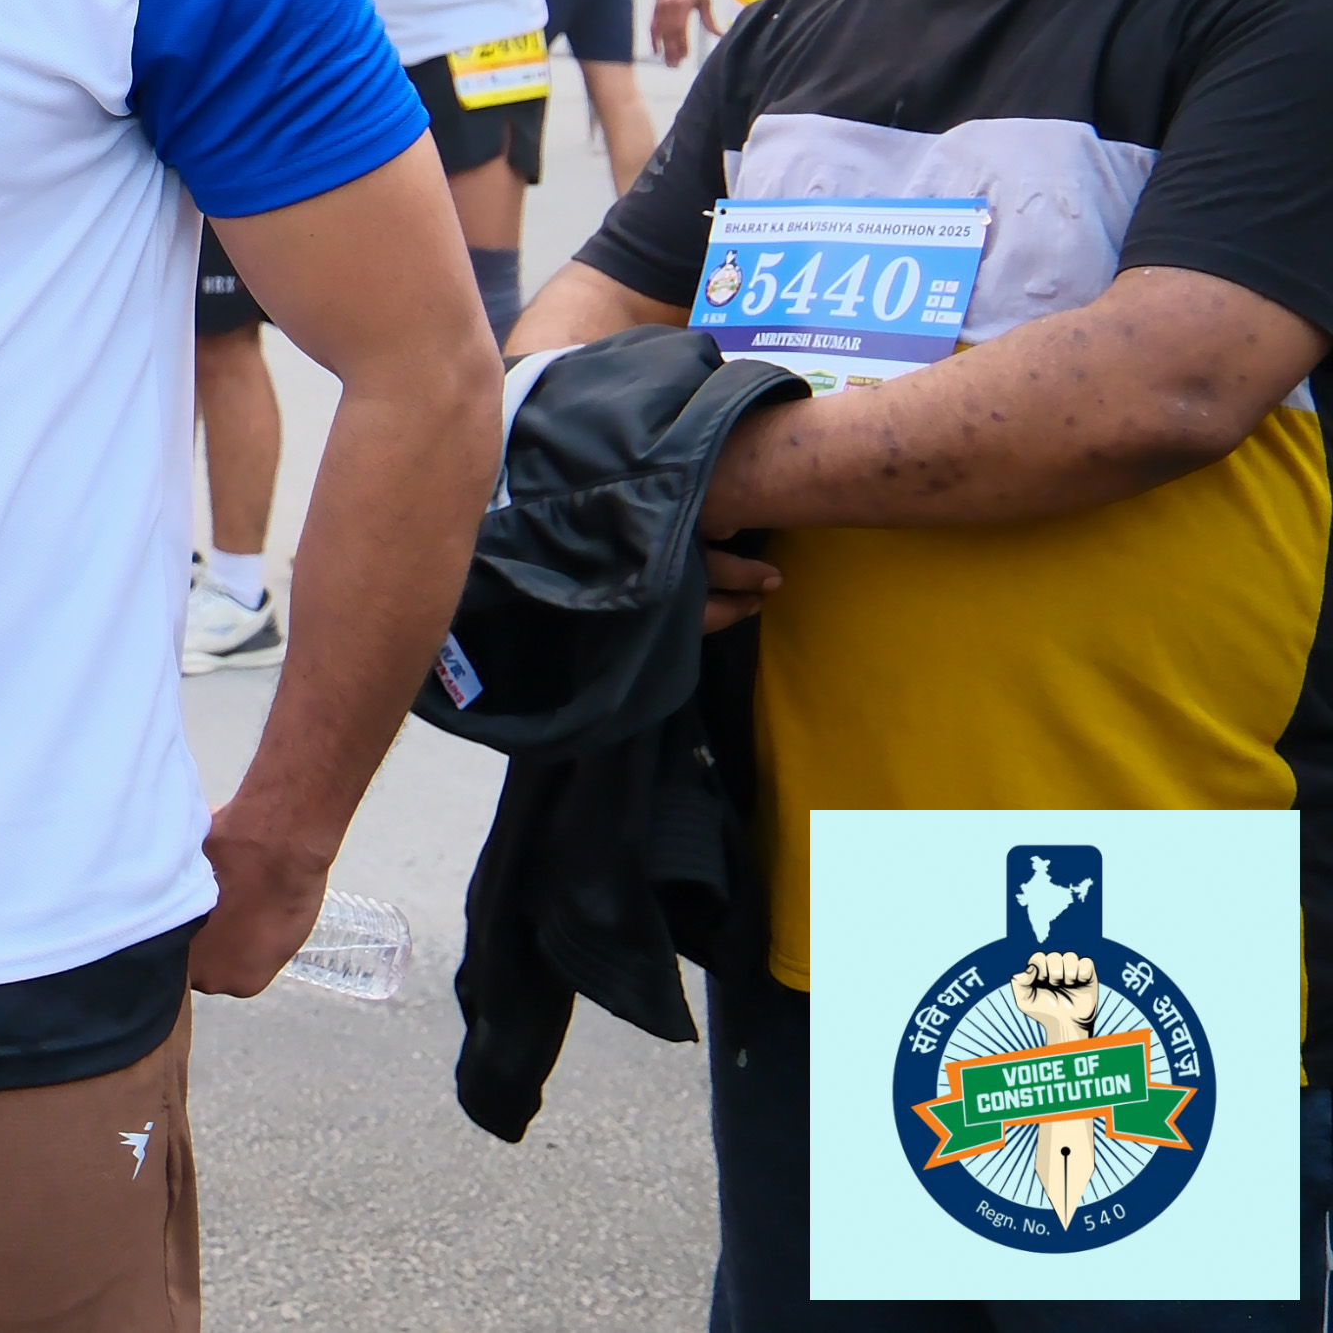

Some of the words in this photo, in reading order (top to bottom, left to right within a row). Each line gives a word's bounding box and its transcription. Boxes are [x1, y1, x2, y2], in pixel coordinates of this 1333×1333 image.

[724, 222, 768, 234] BHARAT
[770, 223, 784, 234] KA
[787, 221, 853, 235] BHAVISHYA
[856, 223, 936, 237] SHAHOTHON
[938, 225, 972, 237] 2025
[741, 251, 921, 321] 5440
[751, 332, 812, 347] AMRITESH
[812, 333, 862, 351] KUMAR
